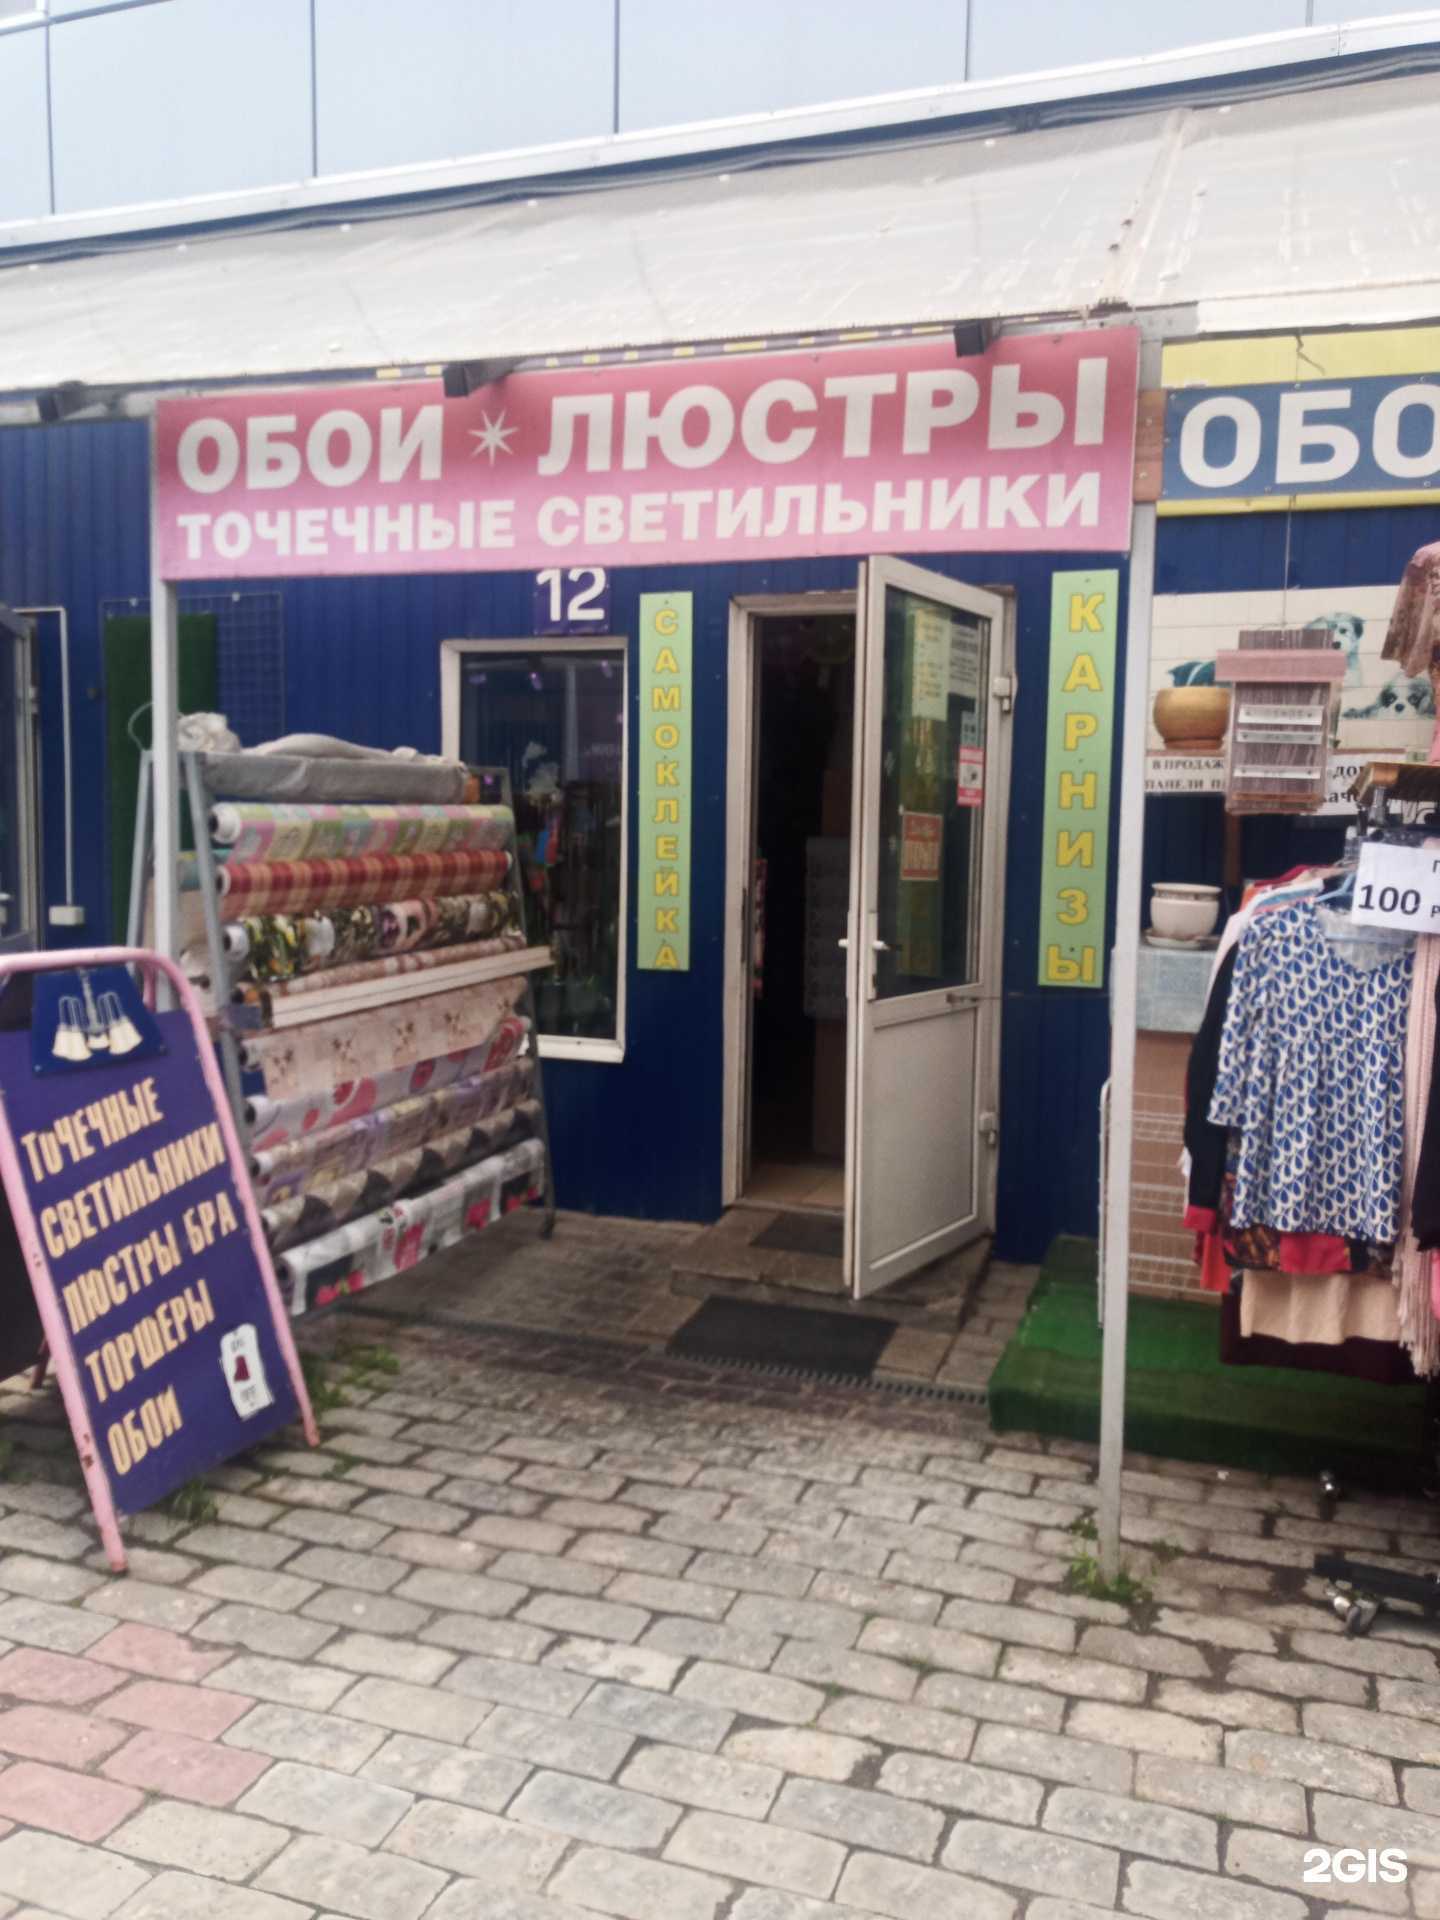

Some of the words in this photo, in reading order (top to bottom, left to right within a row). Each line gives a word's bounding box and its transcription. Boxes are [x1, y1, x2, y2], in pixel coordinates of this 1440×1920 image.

[177, 404, 444, 494] ОБОИ
[538, 357, 1108, 477] ЛЮСТРЫ
[177, 499, 515, 560] ТОЧЕЧНЫЕ
[537, 471, 1101, 548] СВЕТИЛЬНИКИ
[535, 567, 607, 622] 12
[1045, 592, 1105, 984] КАРНИЗЫ
[1358, 884, 1422, 916] 100
[40, 1122, 227, 1260] СВЕТИЛЬНИКИ
[183, 1191, 239, 1256] БРА
[84, 1279, 216, 1404] ТОРШЕРЫ
[106, 1384, 184, 1476] ОБОИ
